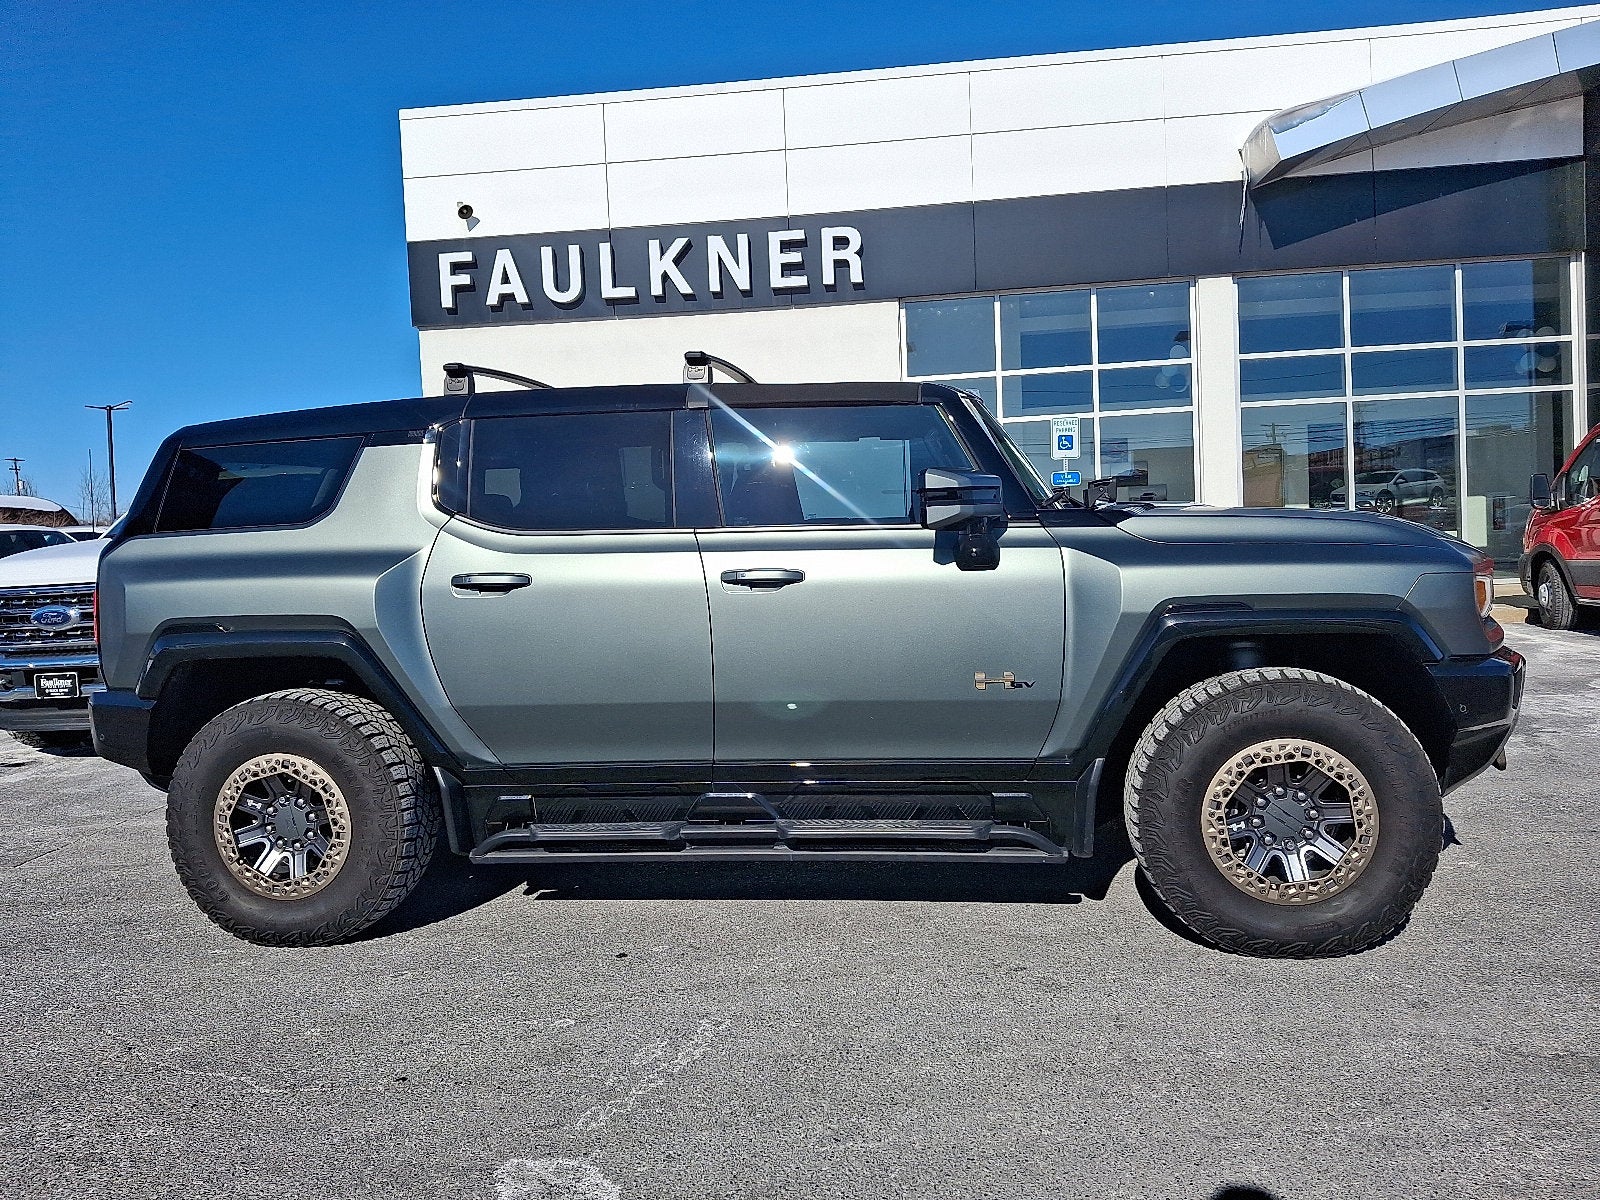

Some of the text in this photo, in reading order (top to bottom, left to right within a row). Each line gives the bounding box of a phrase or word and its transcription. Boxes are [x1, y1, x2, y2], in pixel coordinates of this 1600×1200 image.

[438, 226, 865, 310] FAULKNER
[40, 612, 64, 624] Ford
[40, 678, 73, 688] Faulkner
